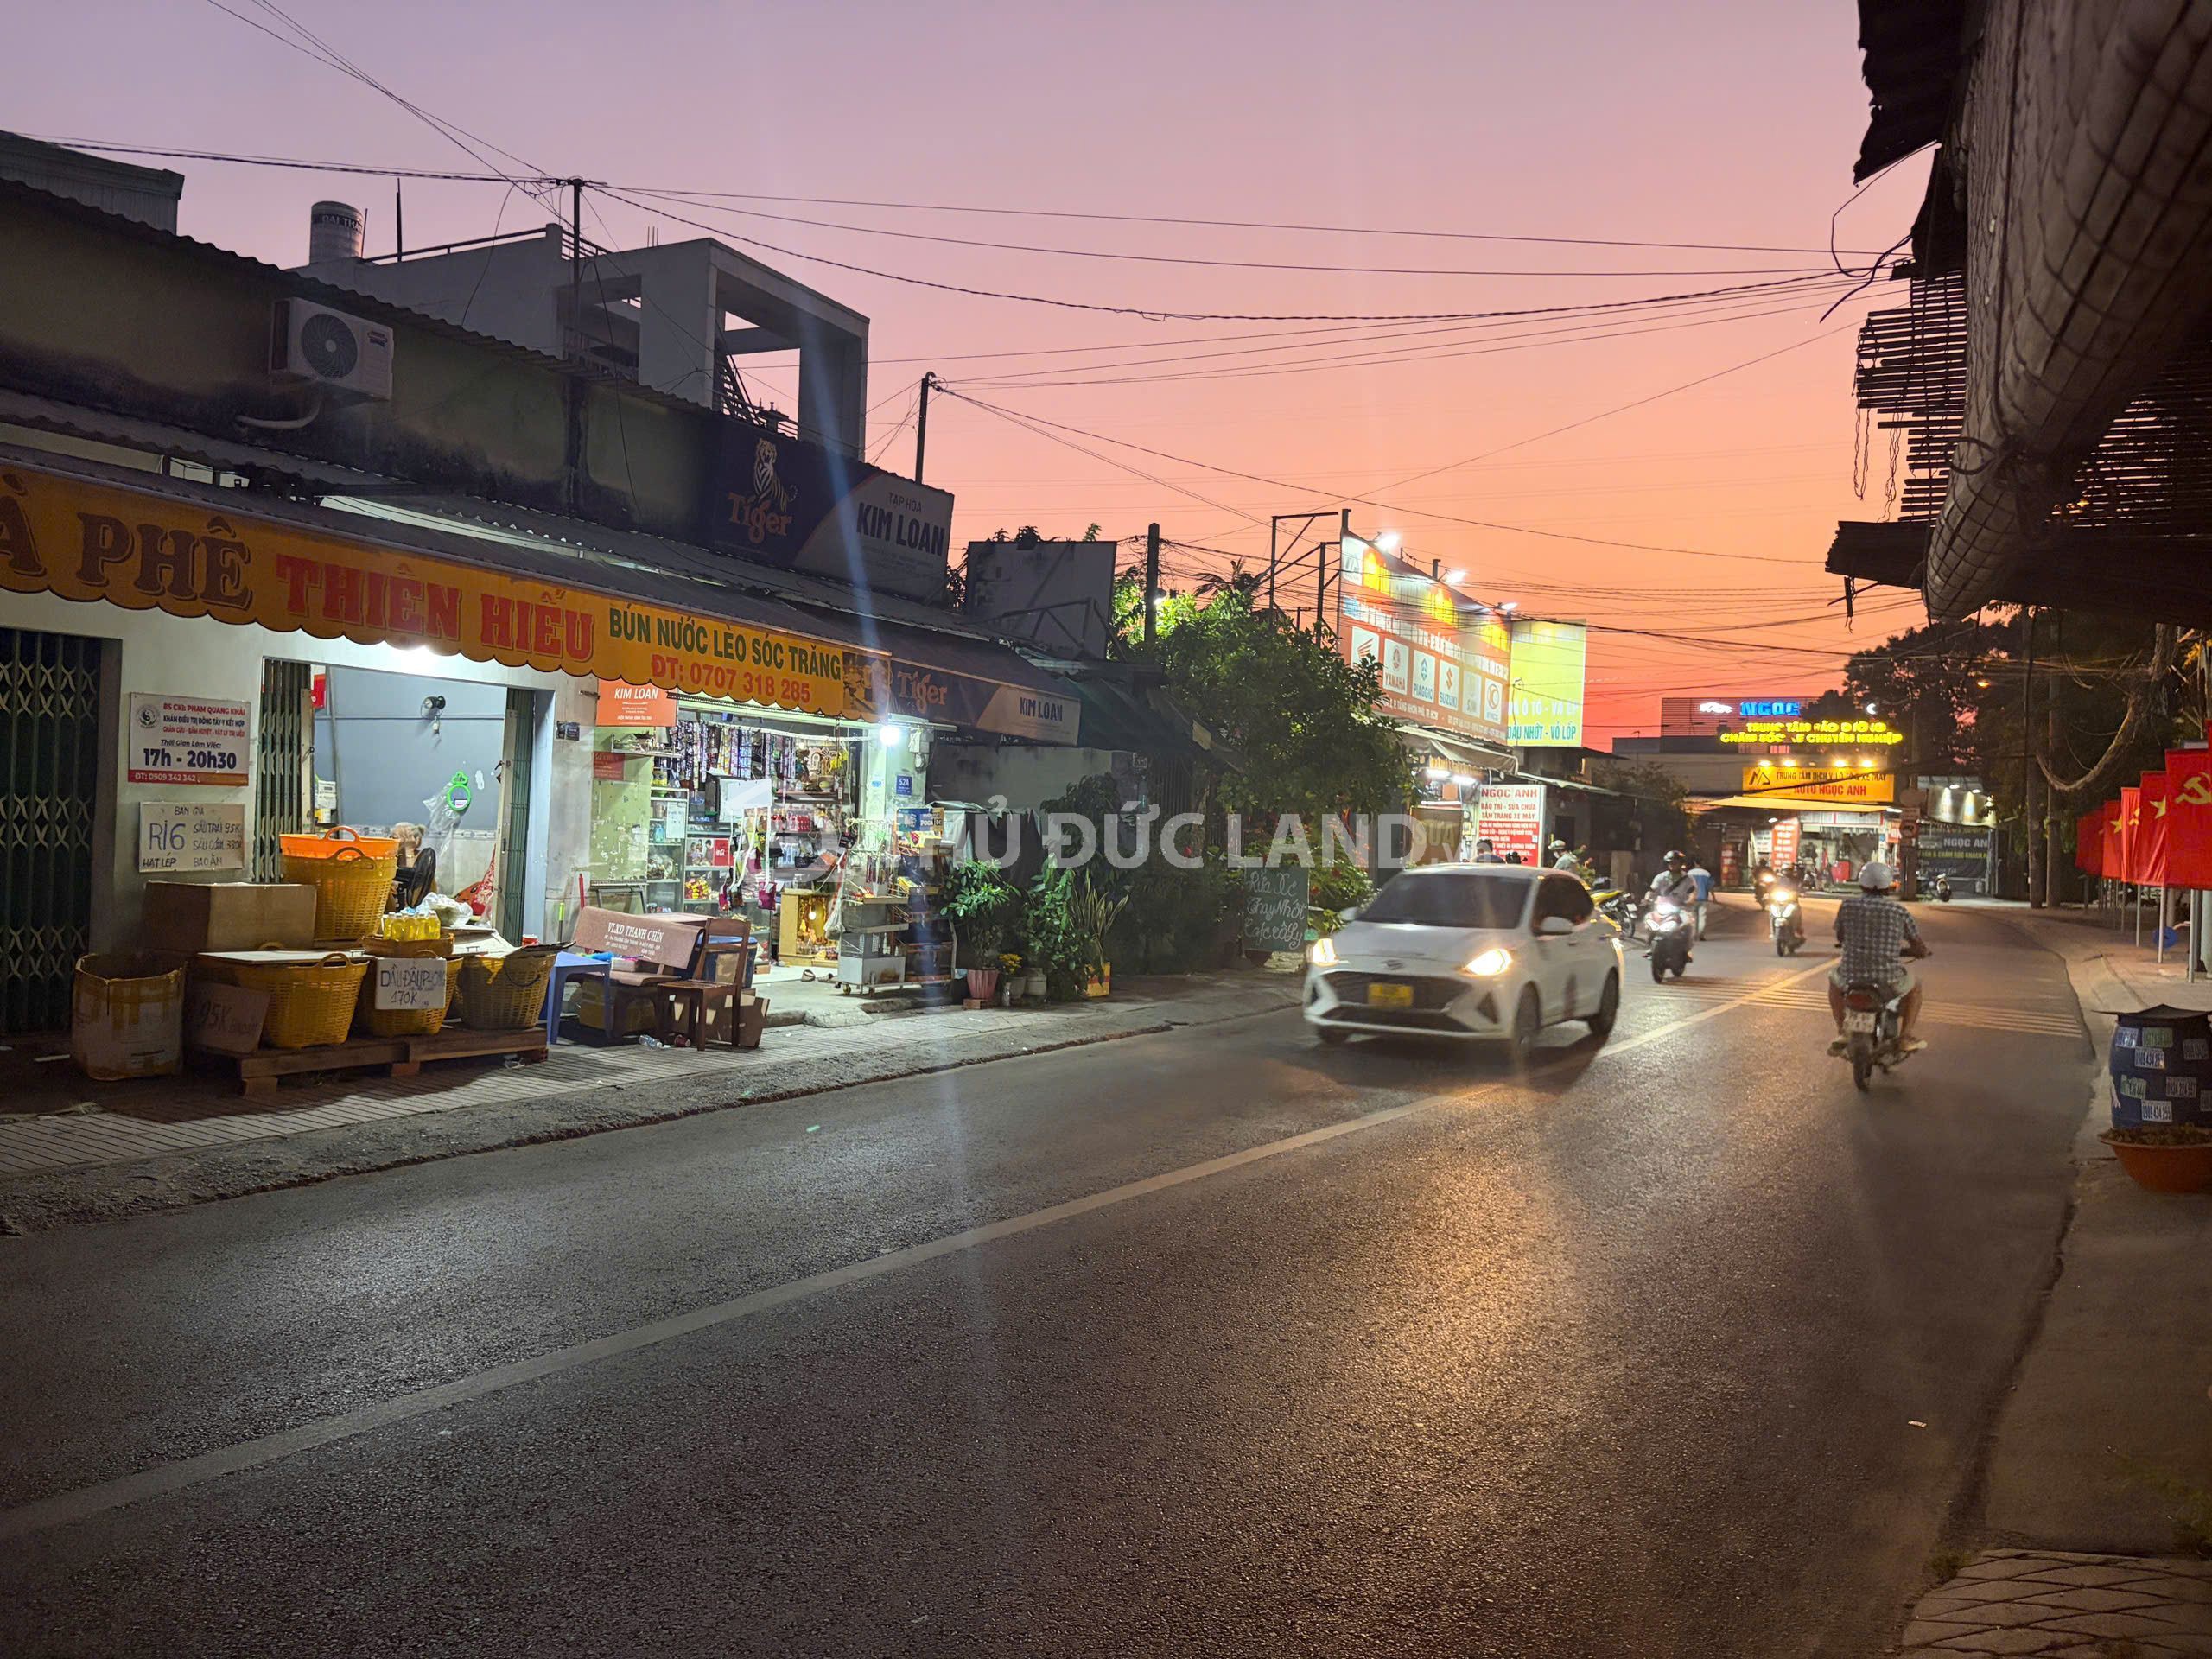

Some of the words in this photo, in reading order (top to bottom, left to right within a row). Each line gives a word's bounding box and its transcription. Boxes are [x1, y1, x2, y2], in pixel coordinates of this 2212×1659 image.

[728, 492, 793, 544] Tiger
[856, 502, 893, 543] KIM
[896, 514, 946, 557] LOAN
[76, 516, 253, 611] PHÊ
[480, 588, 596, 664] HIẾU
[610, 604, 651, 644] BÚN
[658, 616, 709, 655] NƯỚC
[714, 624, 747, 663] LÈO
[752, 633, 784, 670] SÓC
[789, 645, 842, 681] TRĂNG
[652, 654, 683, 681] ĐT:
[690, 663, 736, 691] 0707
[743, 671, 775, 697] 318
[781, 677, 810, 704] 285
[1385, 672, 1406, 690] YAMAHA
[614, 688, 632, 699] KIM
[634, 689, 658, 699] LOAN
[898, 671, 948, 715] Tiger
[1440, 691, 1458, 709] SUZUKI
[208, 707, 229, 715] QUANG
[1020, 697, 1036, 719] KIM
[1038, 700, 1063, 722] LOAN
[143, 748, 171, 766] 17h
[187, 750, 237, 769] 20h30
[1481, 788, 1510, 799] NGỌC
[1515, 788, 1537, 798] ANH
[1819, 785, 1843, 797] NGỌC
[1847, 785, 1866, 796] ANH
[1943, 838, 1971, 849] NGỌC
[1974, 838, 1987, 847] AN
[607, 922, 624, 935] VLXD
[625, 925, 647, 940] THANH
[391, 990, 417, 1005] 170K
